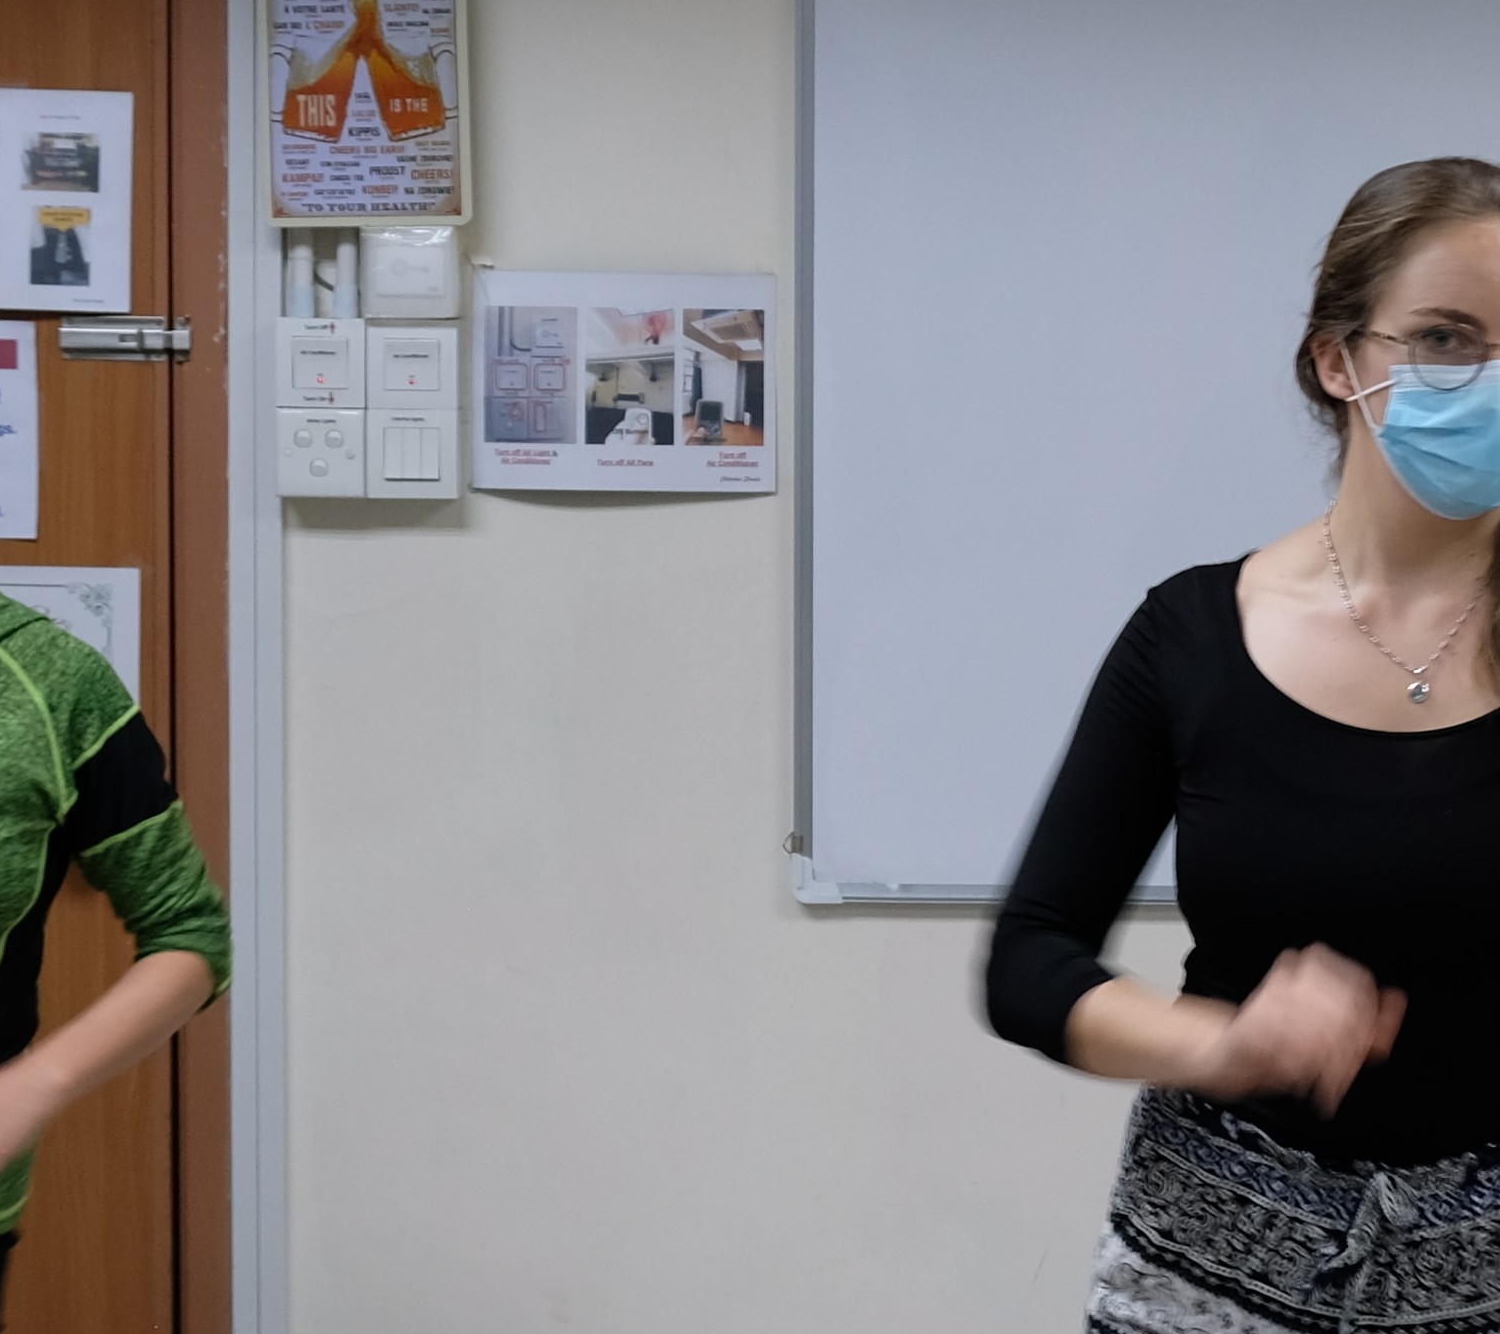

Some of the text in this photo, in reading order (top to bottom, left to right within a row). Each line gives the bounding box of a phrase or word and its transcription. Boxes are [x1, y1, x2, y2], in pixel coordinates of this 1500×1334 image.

[296, 94, 337, 127] THIS
[389, 98, 428, 114] IS THE
[327, 203, 366, 212] YOUR
